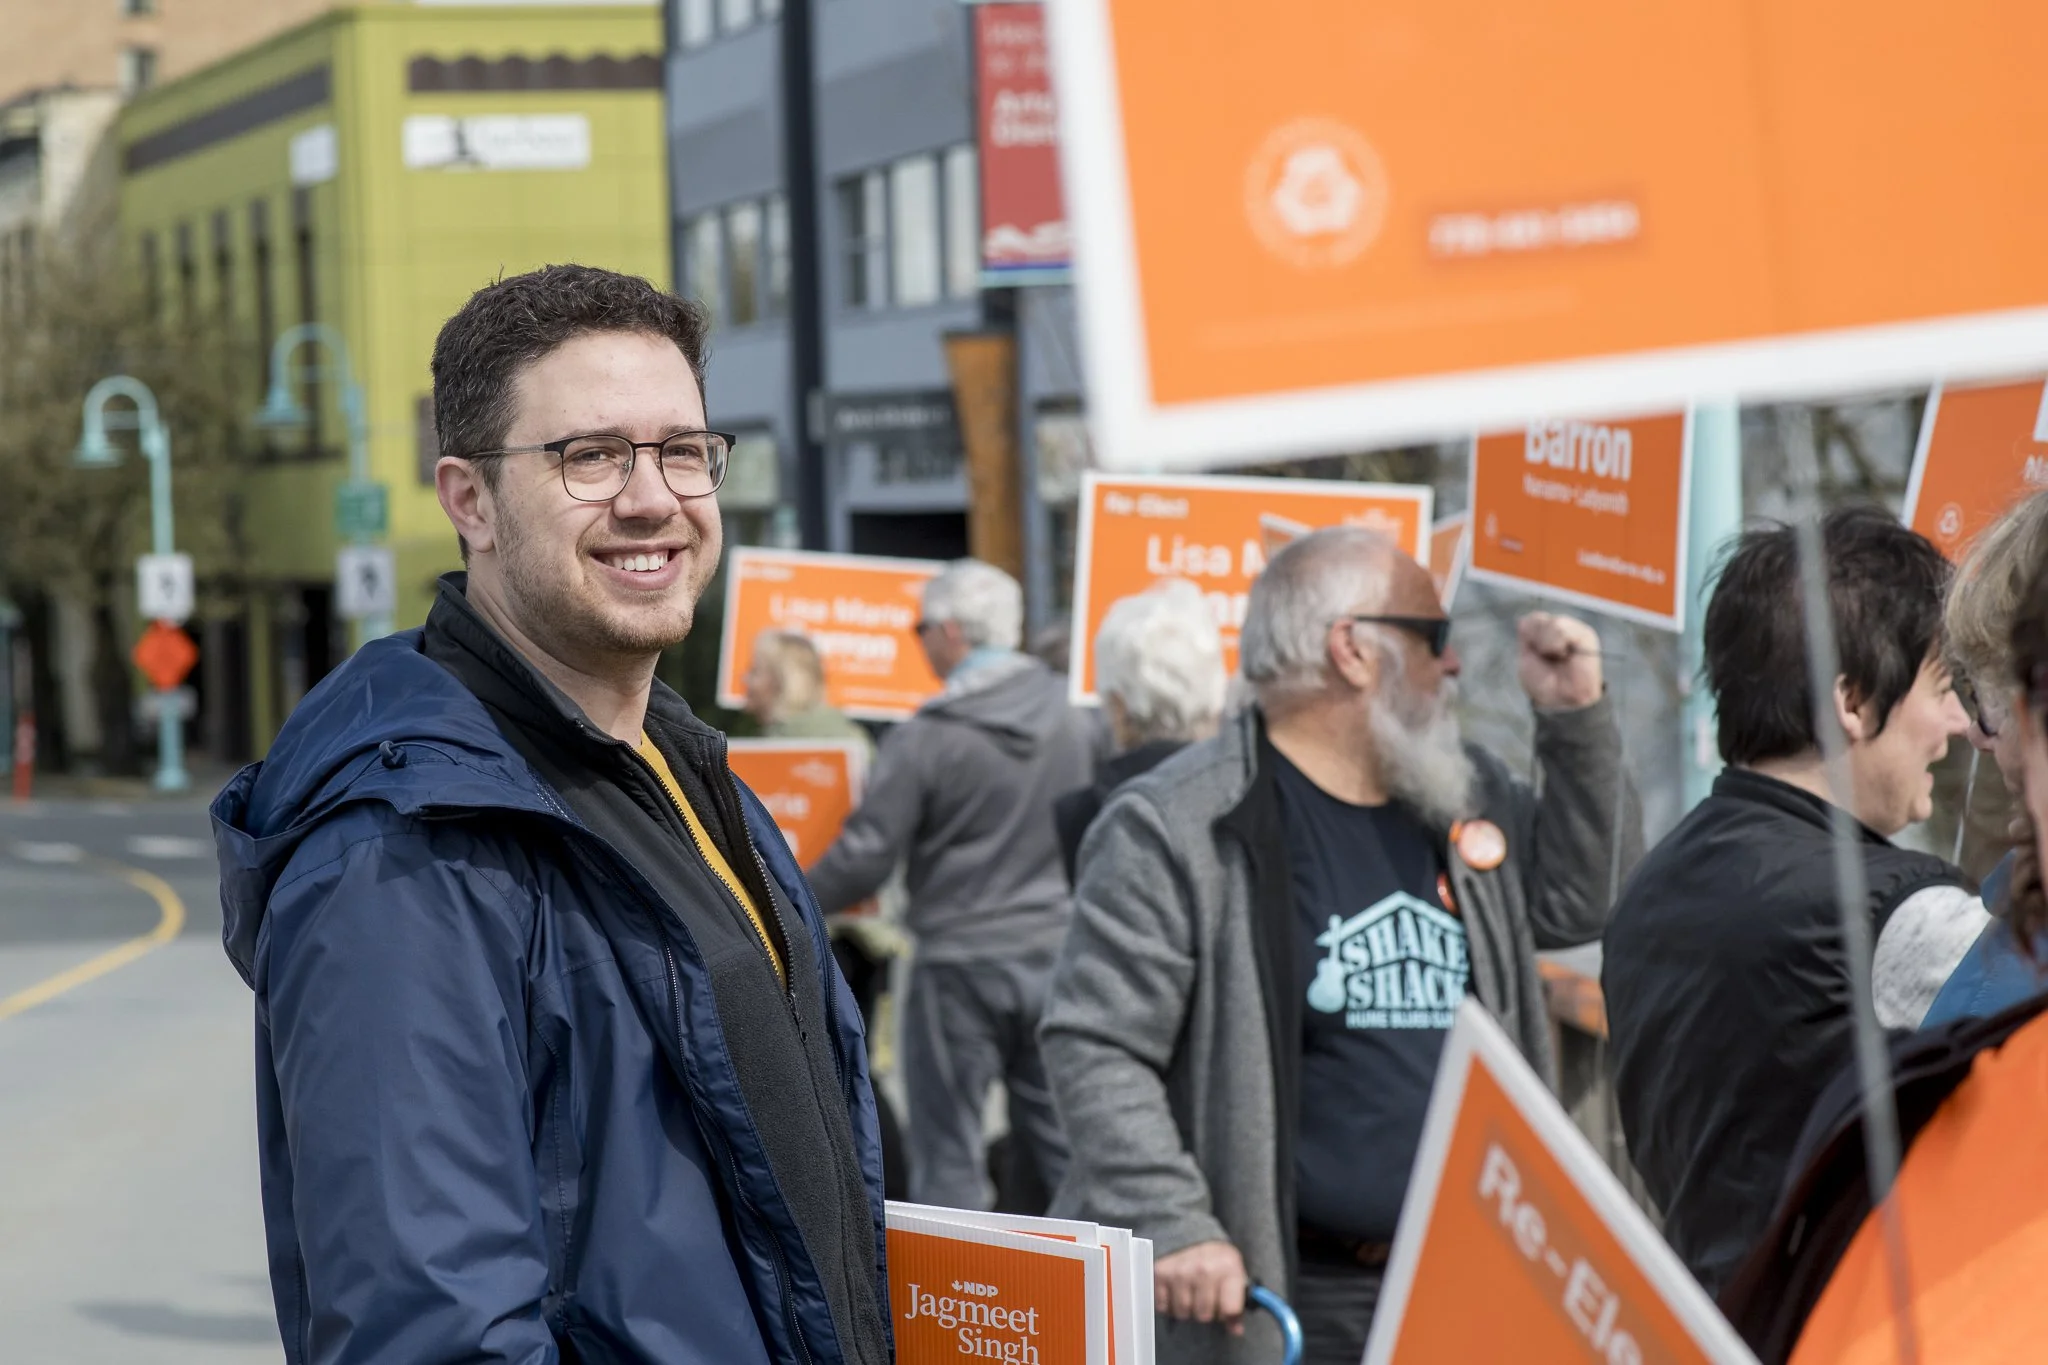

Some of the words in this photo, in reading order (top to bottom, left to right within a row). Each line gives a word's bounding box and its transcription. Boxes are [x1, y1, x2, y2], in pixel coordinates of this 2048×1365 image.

[1524, 417, 1632, 481] Barron
[1146, 534, 1232, 577] Lisa
[769, 592, 829, 625] Lisa
[832, 595, 915, 631] Marie
[1341, 907, 1469, 973] SHAKE
[1346, 958, 1469, 1010] SHACK
[1479, 1144, 1643, 1365] Re-Ele
[904, 1283, 1040, 1336] Jagmeet
[963, 1281, 999, 1298] NDP
[958, 1327, 1039, 1365] Singh
